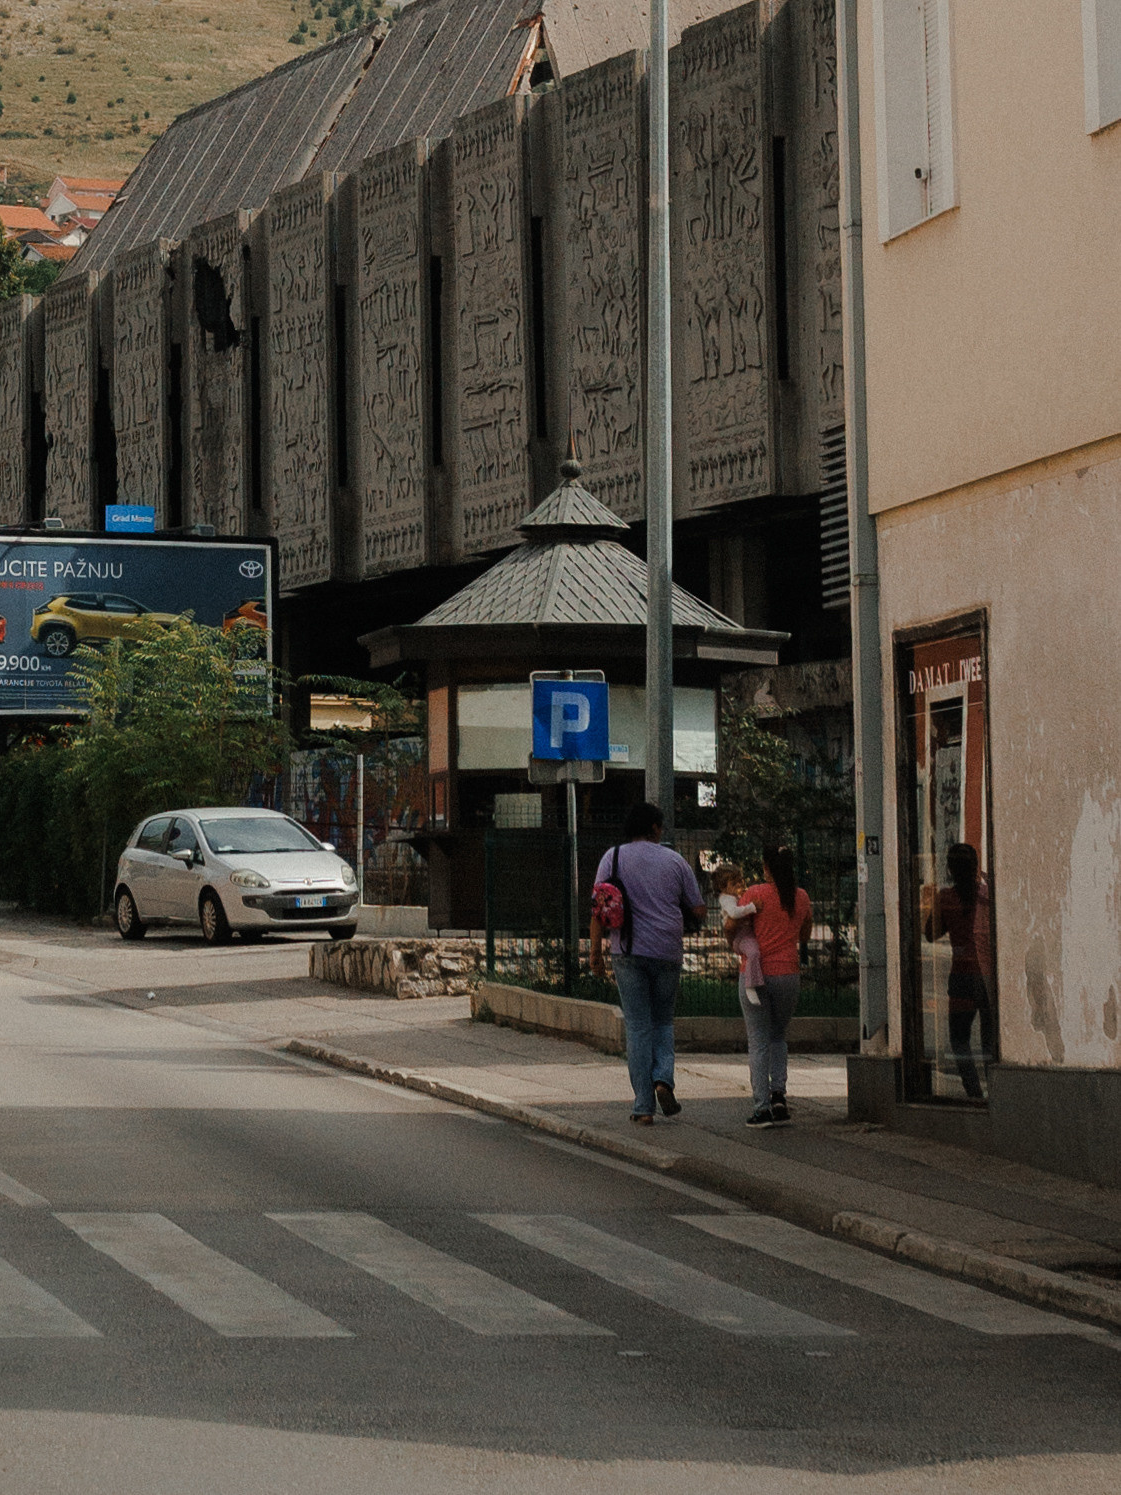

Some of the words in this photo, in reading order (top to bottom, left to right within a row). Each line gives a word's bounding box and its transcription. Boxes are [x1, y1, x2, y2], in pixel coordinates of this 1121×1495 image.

[111, 514, 130, 522] Grad
[54, 558, 123, 579] PAŽNJU
[36, 679, 63, 687] TOYOTA
[909, 662, 951, 695] DAMAT
[550, 691, 590, 748] P
